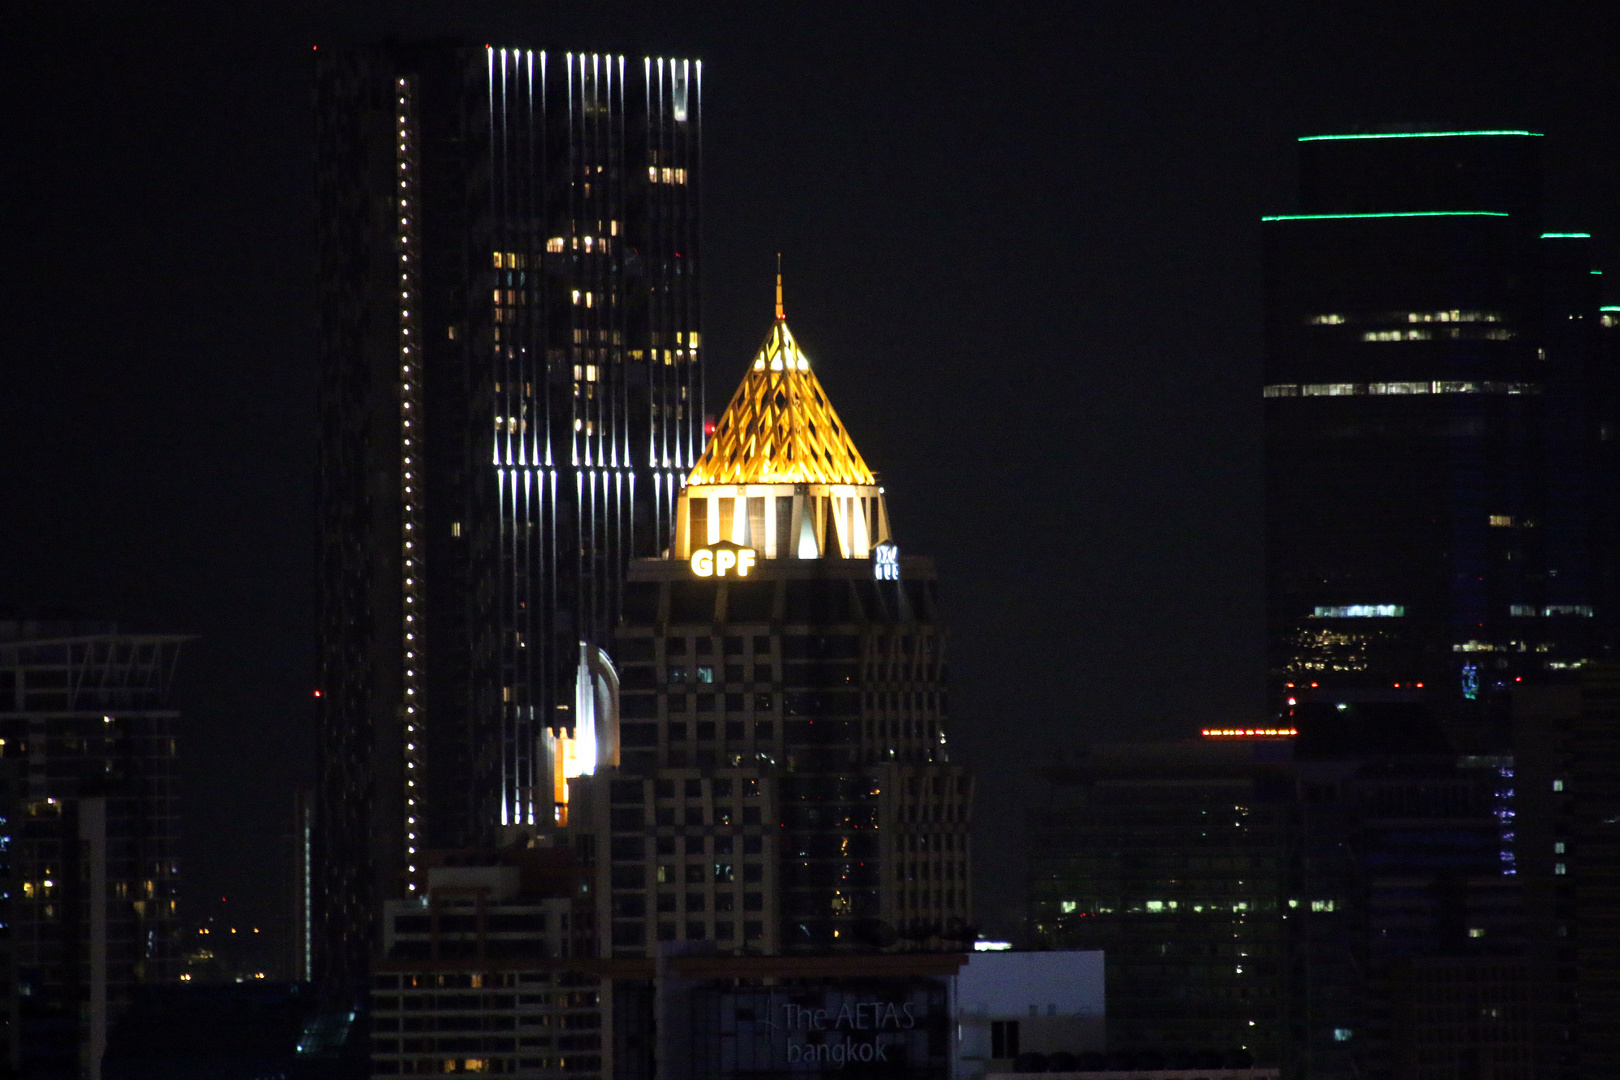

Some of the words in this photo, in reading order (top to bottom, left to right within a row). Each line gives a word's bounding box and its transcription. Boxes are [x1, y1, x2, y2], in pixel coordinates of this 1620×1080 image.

[691, 549, 756, 577] GPF
[782, 1003, 827, 1030] The
[835, 1002, 915, 1030] AETAS
[787, 1035, 888, 1069] bangkok
